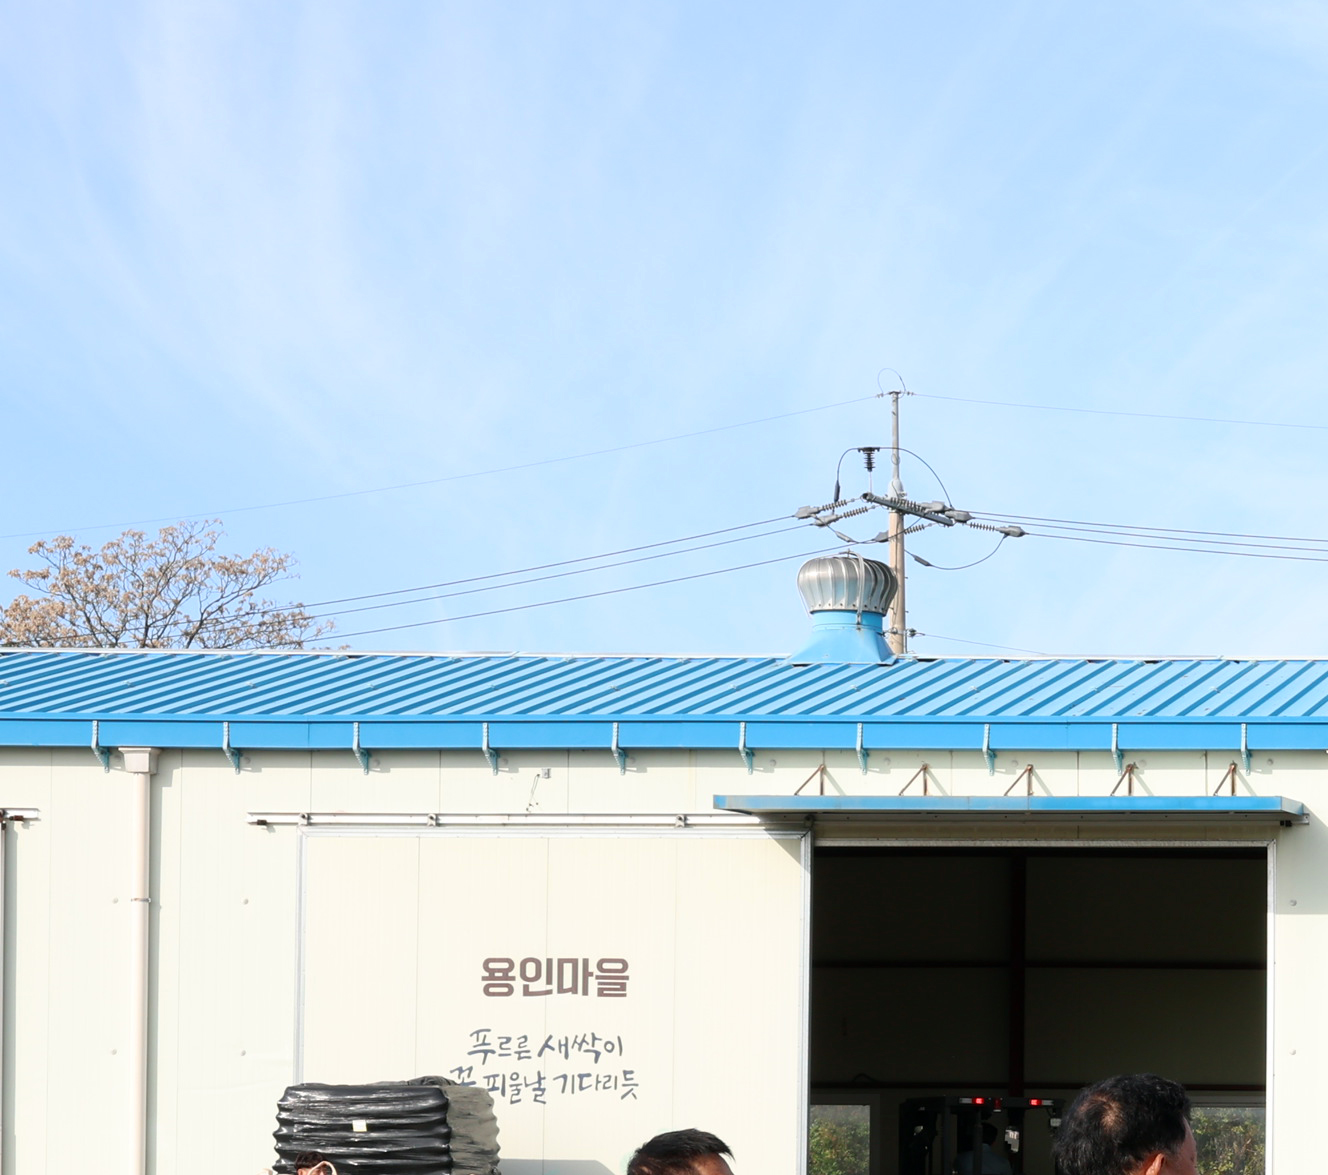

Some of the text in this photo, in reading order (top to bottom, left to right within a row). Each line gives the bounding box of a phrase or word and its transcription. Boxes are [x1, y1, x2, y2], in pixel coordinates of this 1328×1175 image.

[481, 957, 630, 997] 용인마을
[467, 1028, 623, 1065] 푸르른 새싹이
[483, 1070, 547, 1105] 피울날
[553, 1069, 639, 1100] 기다리듯
